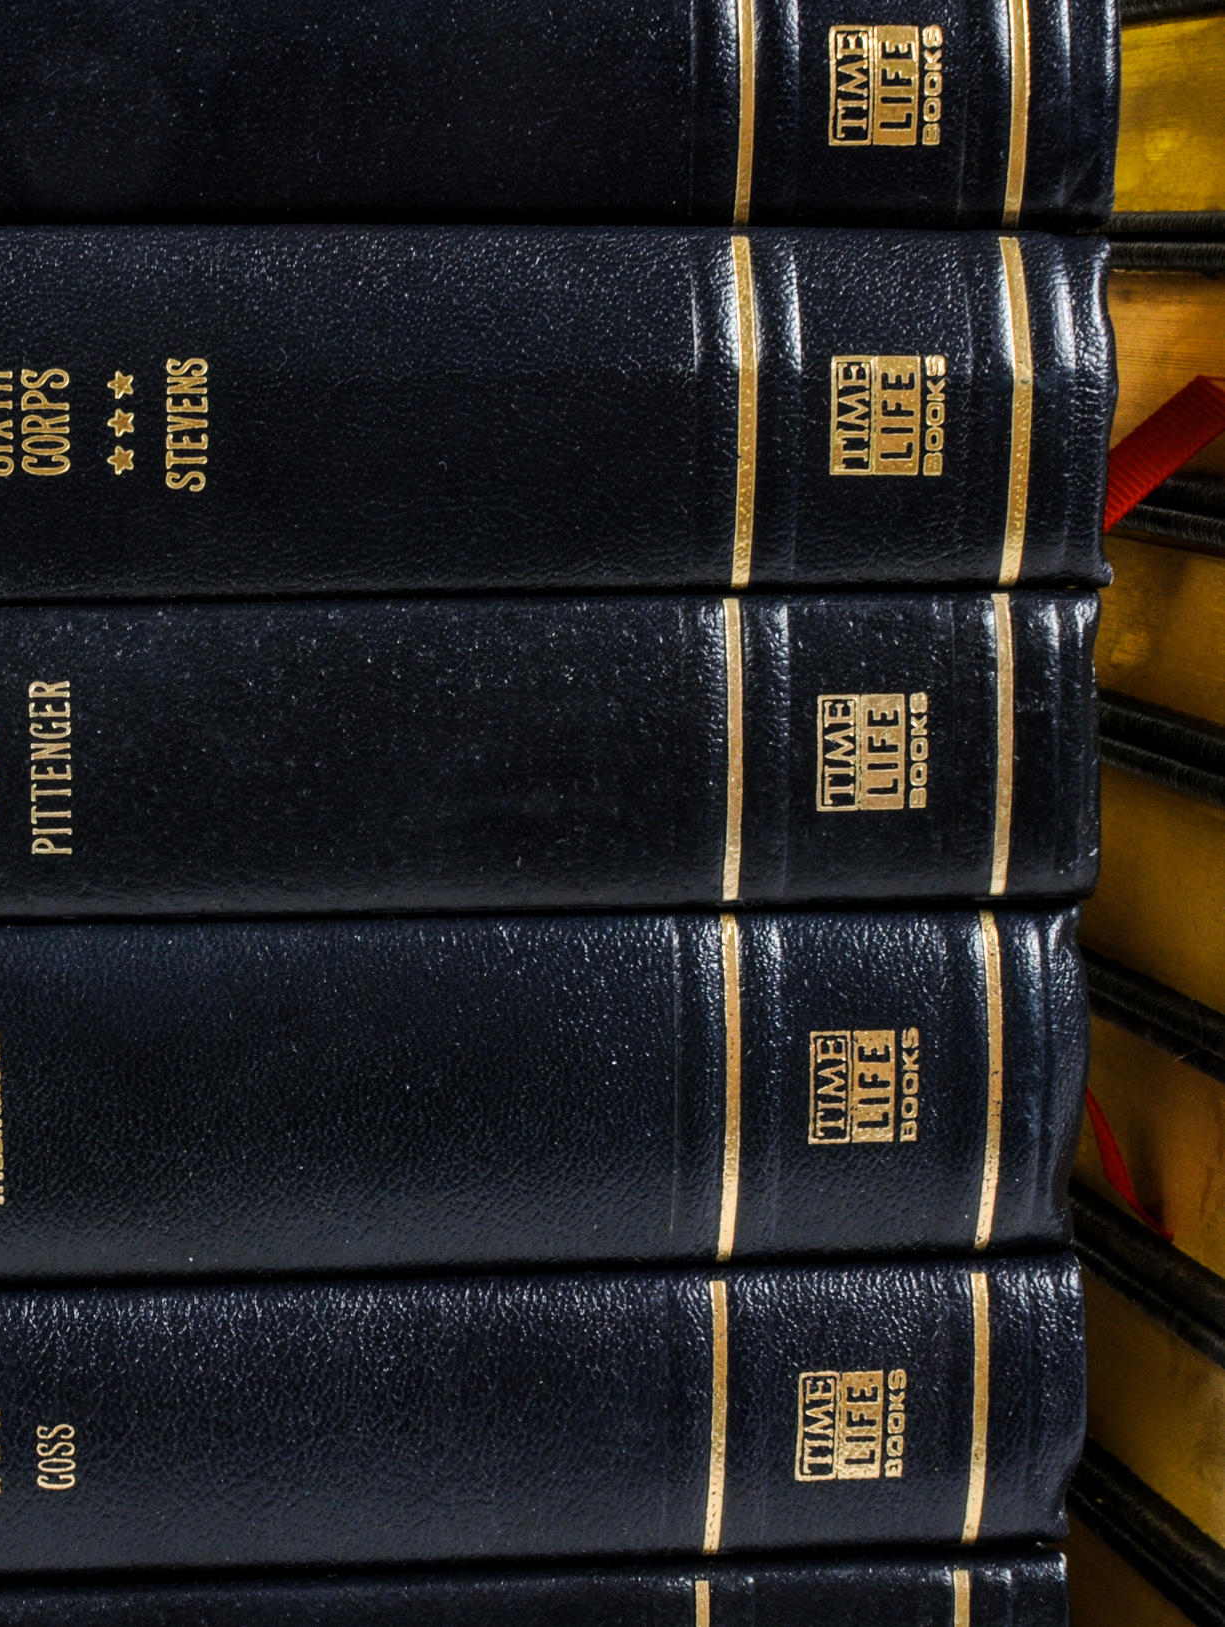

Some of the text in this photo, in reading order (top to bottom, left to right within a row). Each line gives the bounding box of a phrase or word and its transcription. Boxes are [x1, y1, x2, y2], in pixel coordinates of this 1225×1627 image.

[837, 32, 868, 138] TIME
[880, 41, 916, 129] LIFE
[922, 24, 943, 145] BOOKS
[20, 367, 71, 476] CORPS
[165, 357, 209, 492] STEVENS
[836, 363, 870, 470] TIME
[880, 372, 915, 459] LIFE
[923, 355, 946, 476] BOOKS
[28, 680, 73, 856] PITTENGER
[824, 700, 855, 805] TIME
[867, 709, 899, 794] LIFE
[909, 692, 928, 808] BOOKS
[816, 1038, 847, 1136] TIME
[857, 1045, 891, 1128] LIFE
[900, 1027, 919, 1142] BOOKS
[36, 1423, 76, 1490] GOSS
[803, 1378, 835, 1474] TIME
[845, 1386, 878, 1465] LIFE
[885, 1368, 907, 1477] BOOKS
